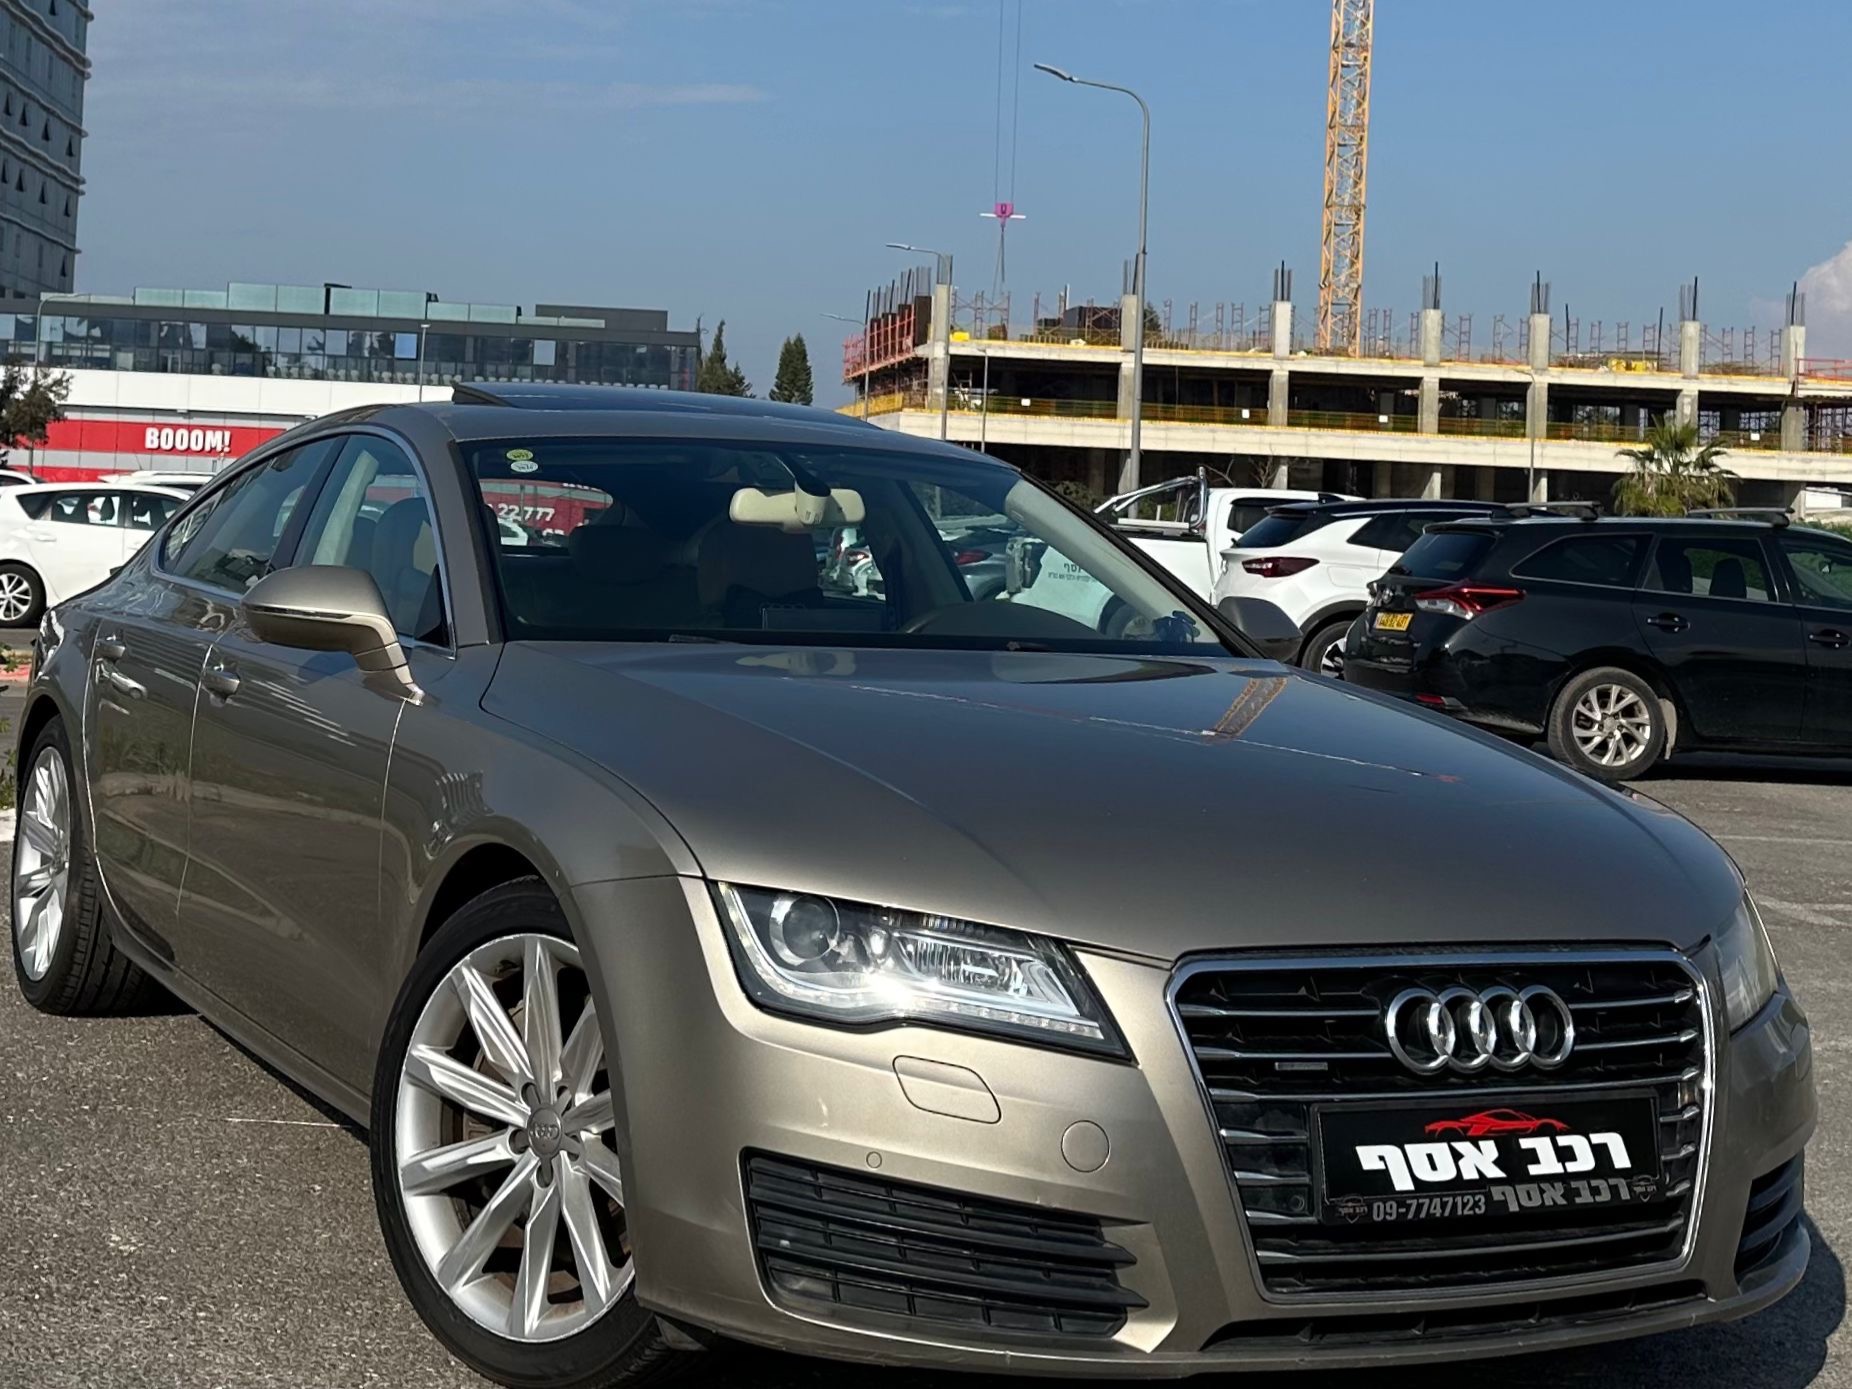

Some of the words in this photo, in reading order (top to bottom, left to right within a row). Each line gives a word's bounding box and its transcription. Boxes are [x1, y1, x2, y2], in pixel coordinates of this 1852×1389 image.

[145, 428, 231, 452] BOOOM!
[1355, 1140, 1507, 1191] אסף
[1519, 1132, 1632, 1176] רכב
[1489, 1183, 1566, 1212] אסף
[1570, 1178, 1630, 1203] רכב
[1372, 1194, 1486, 1222] 09-7747123
